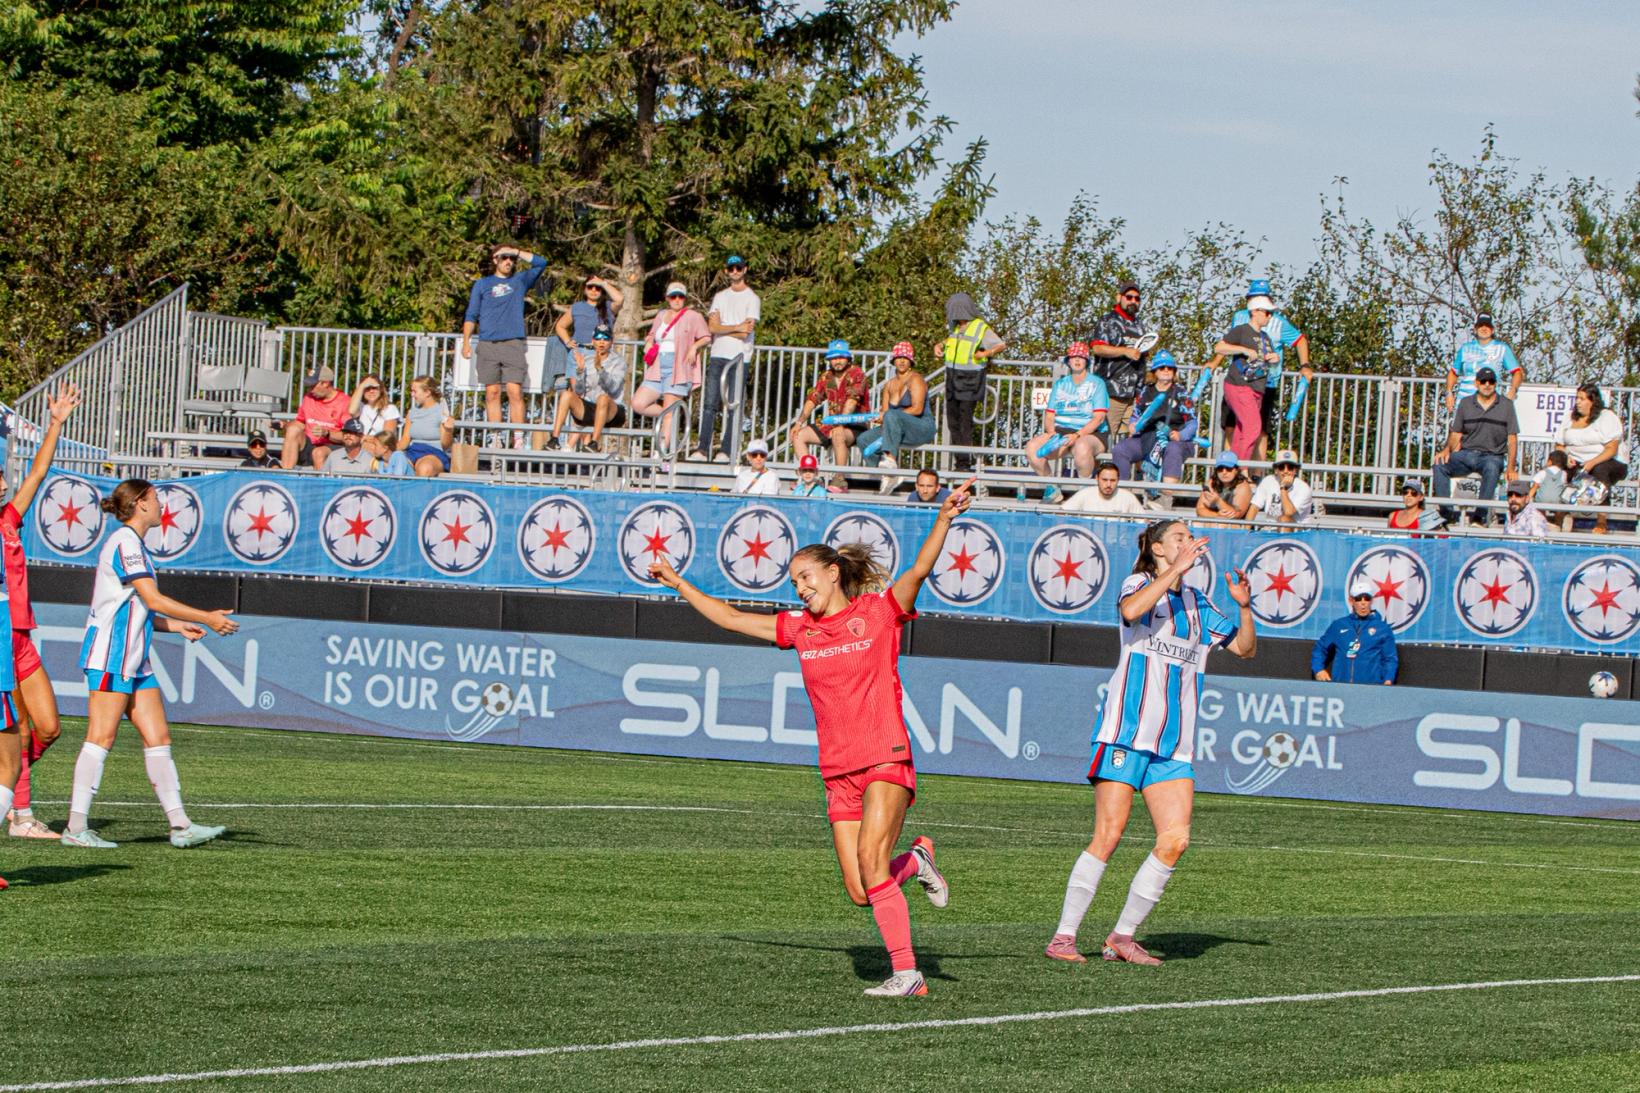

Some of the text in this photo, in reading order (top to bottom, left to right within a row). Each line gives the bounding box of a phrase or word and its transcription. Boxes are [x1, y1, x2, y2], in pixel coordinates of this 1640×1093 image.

[1536, 394, 1577, 411] EAST
[325, 634, 557, 679] SAVING WATER
[324, 671, 555, 718] IS OUR GOAL
[1236, 692, 1345, 729] WATER
[1231, 729, 1344, 770] GOAL
[1412, 712, 1640, 800] SLO
